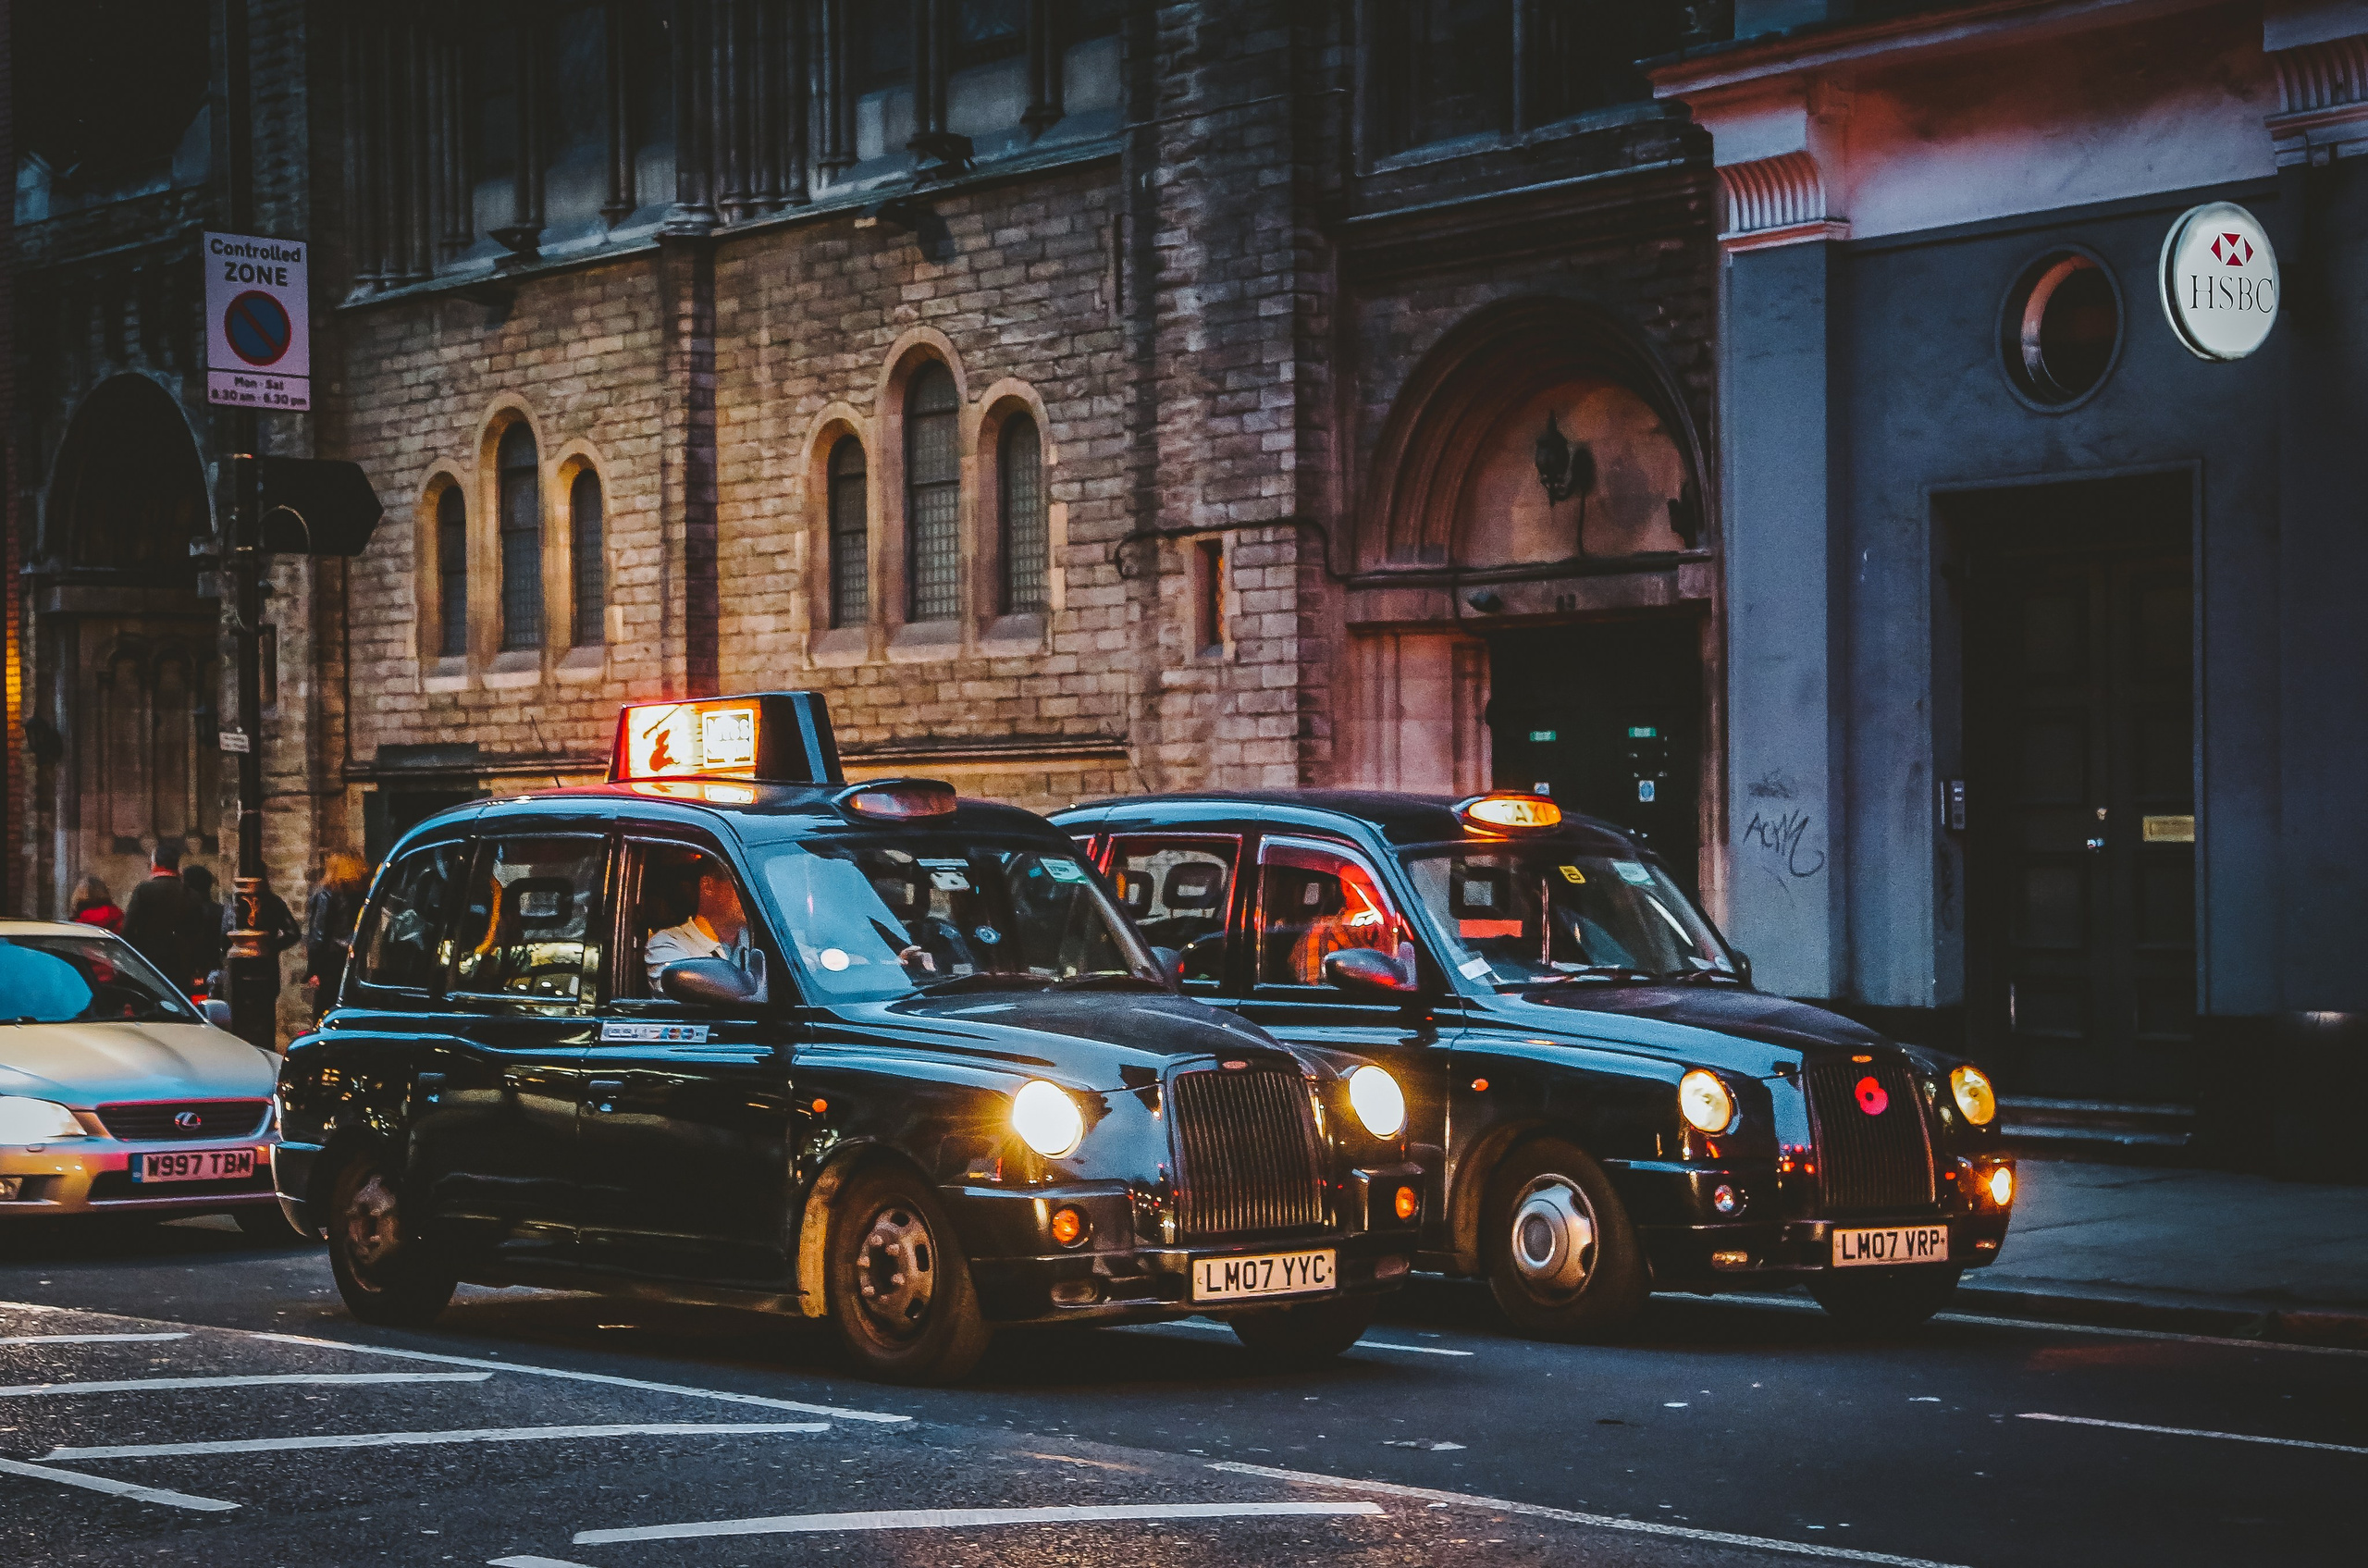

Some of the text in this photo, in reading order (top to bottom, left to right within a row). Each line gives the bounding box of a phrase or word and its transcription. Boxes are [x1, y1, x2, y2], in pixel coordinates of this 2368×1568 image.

[210, 238, 302, 263] Controlled
[224, 261, 289, 287] ZONE
[2189, 274, 2274, 314] HSBC
[234, 376, 258, 389] Mon
[265, 378, 284, 391] Sat
[1843, 1229, 1940, 1260] LM07 VRP
[1205, 1254, 1326, 1292] LM07 YYC
